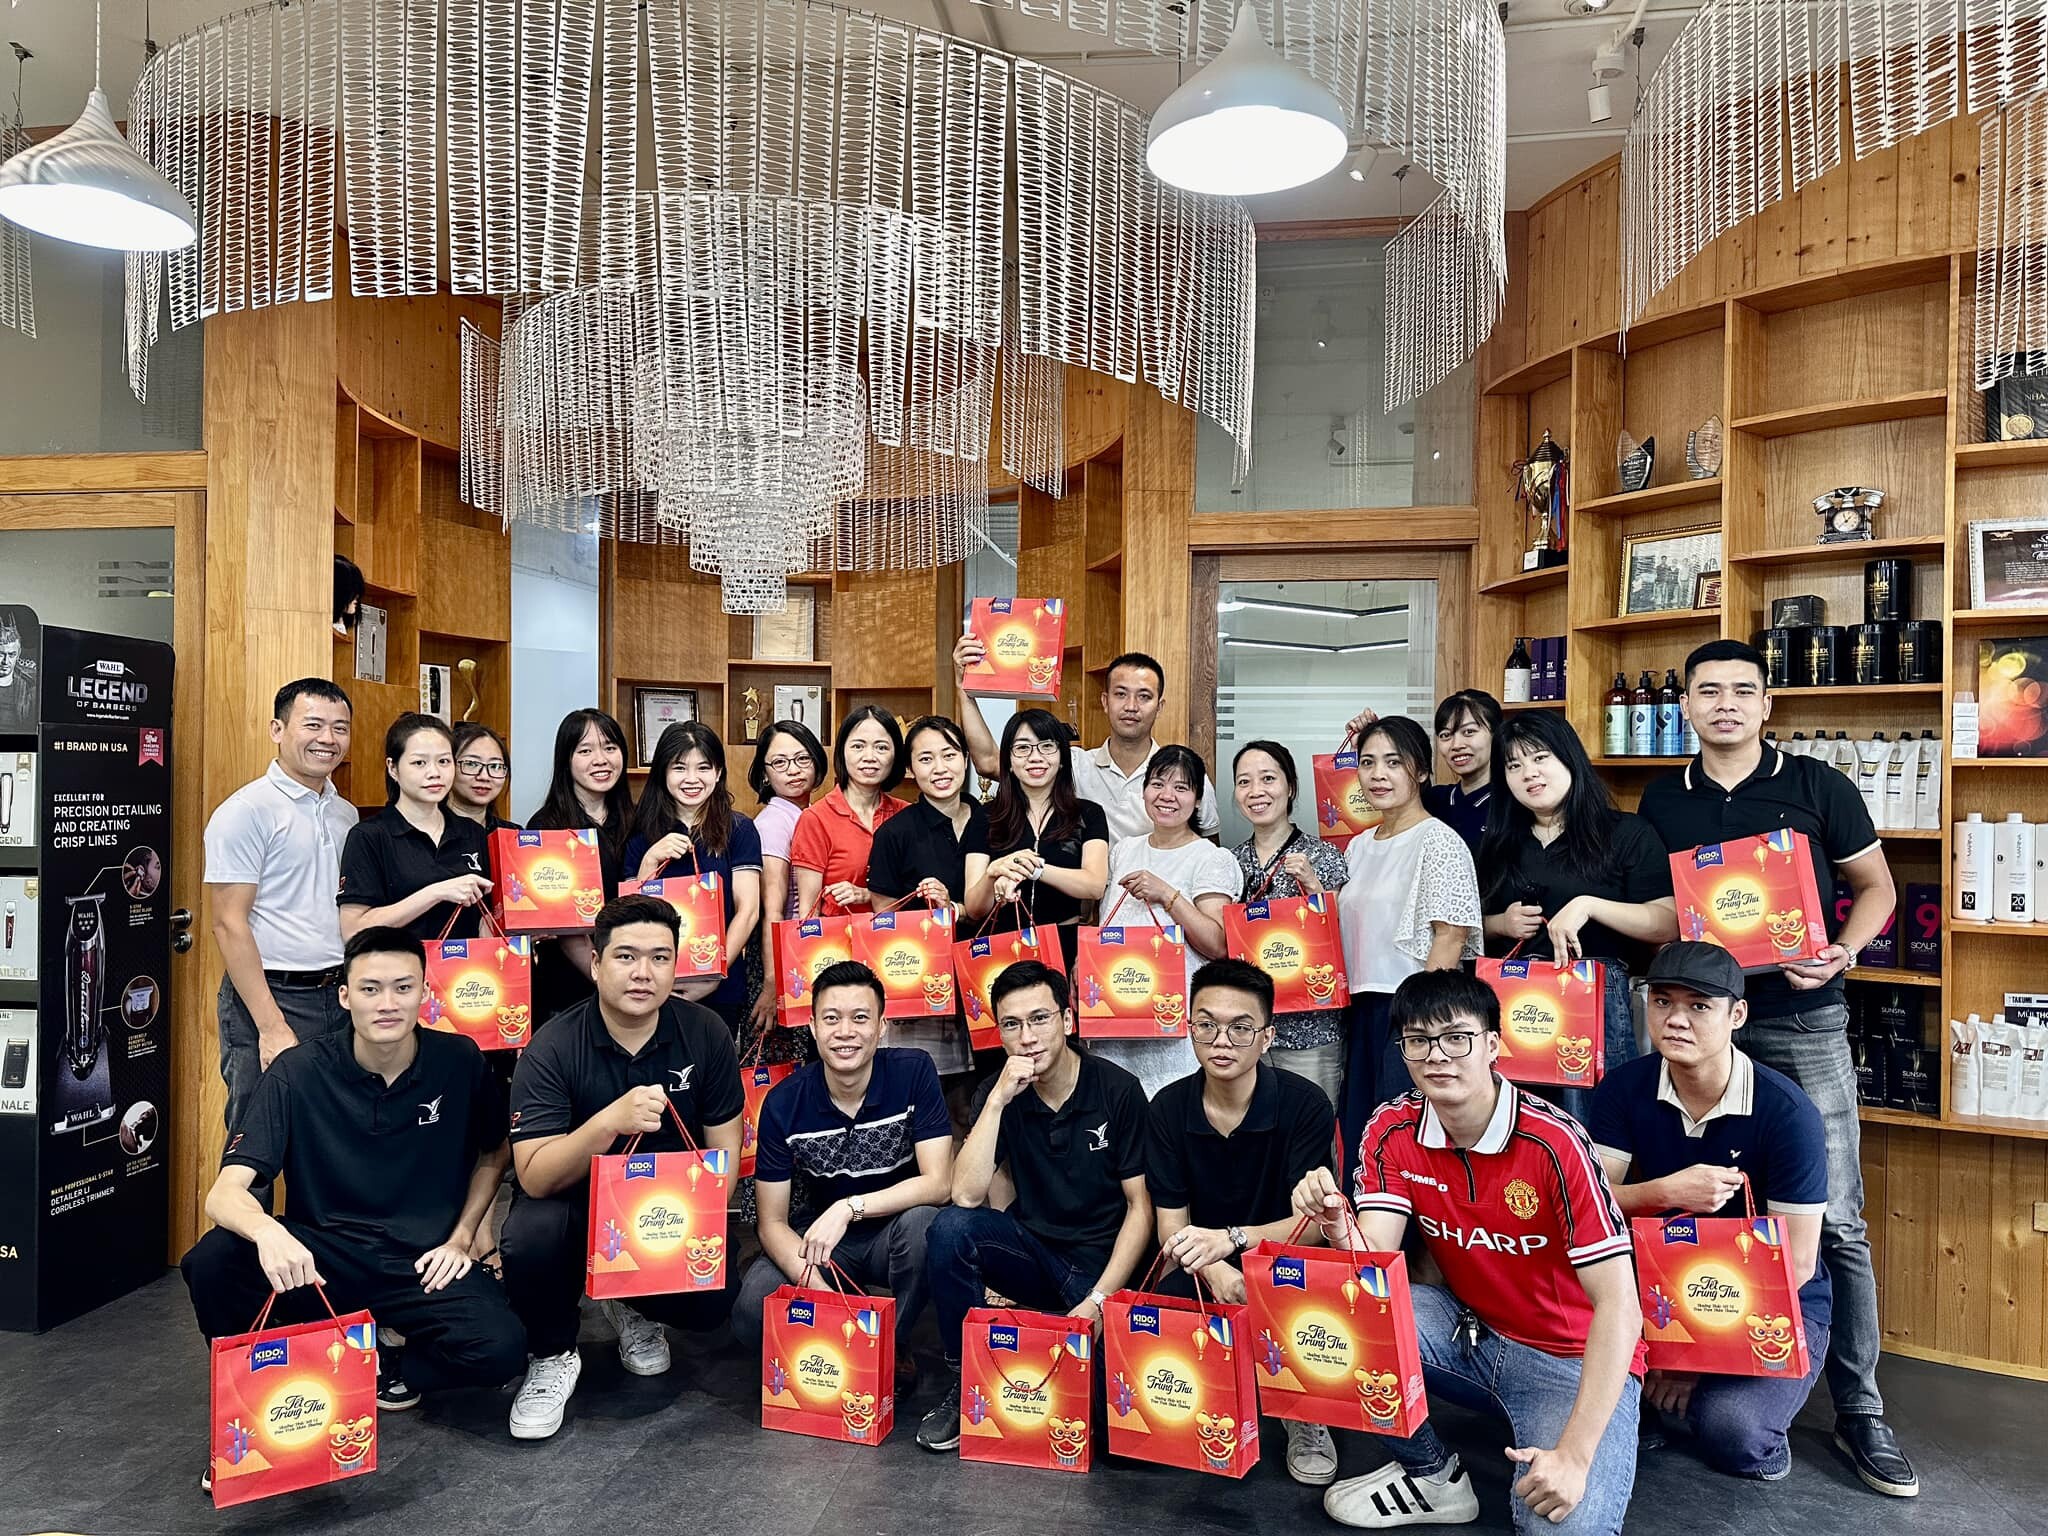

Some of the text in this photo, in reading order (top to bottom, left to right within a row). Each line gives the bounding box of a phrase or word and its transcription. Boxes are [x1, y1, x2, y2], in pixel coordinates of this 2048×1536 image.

[99, 663, 121, 672] WAHL
[67, 676, 148, 703] LEGEND
[93, 702, 137, 711] BARBERS
[66, 741, 98, 752] BRAND
[100, 743, 108, 752] IN
[111, 743, 128, 752] USA
[54, 793, 104, 802] EXCELLENT FOR
[54, 804, 162, 818] PRECISION DETAILING
[54, 819, 130, 834] AND CREATING
[54, 834, 118, 849] CRISP LINES
[1963, 894, 1975, 904] 10
[2012, 896, 2025, 906] 20
[1916, 903, 1941, 938] 9
[1910, 941, 1937, 950] SCALP
[2012, 996, 2032, 1004] TAKUMI
[1881, 1006, 1906, 1015] SUNSPA
[1902, 1070, 1928, 1078] SUNSPA
[70, 1109, 95, 1122] WAHL
[50, 1186, 115, 1216] CORDLESS TRIMMER
[51, 1190, 83, 1206] DETAILER
[1418, 1215, 1549, 1256] SHARP
[1687, 1283, 1740, 1301] Trung Thu
[1296, 1331, 1348, 1351] Trung Thu
[800, 1359, 823, 1377] Trung
[1147, 1375, 1193, 1395] Trung Thu
[1003, 1386, 1047, 1403] Trung Thu
[270, 1398, 326, 1422] Trung Thu
